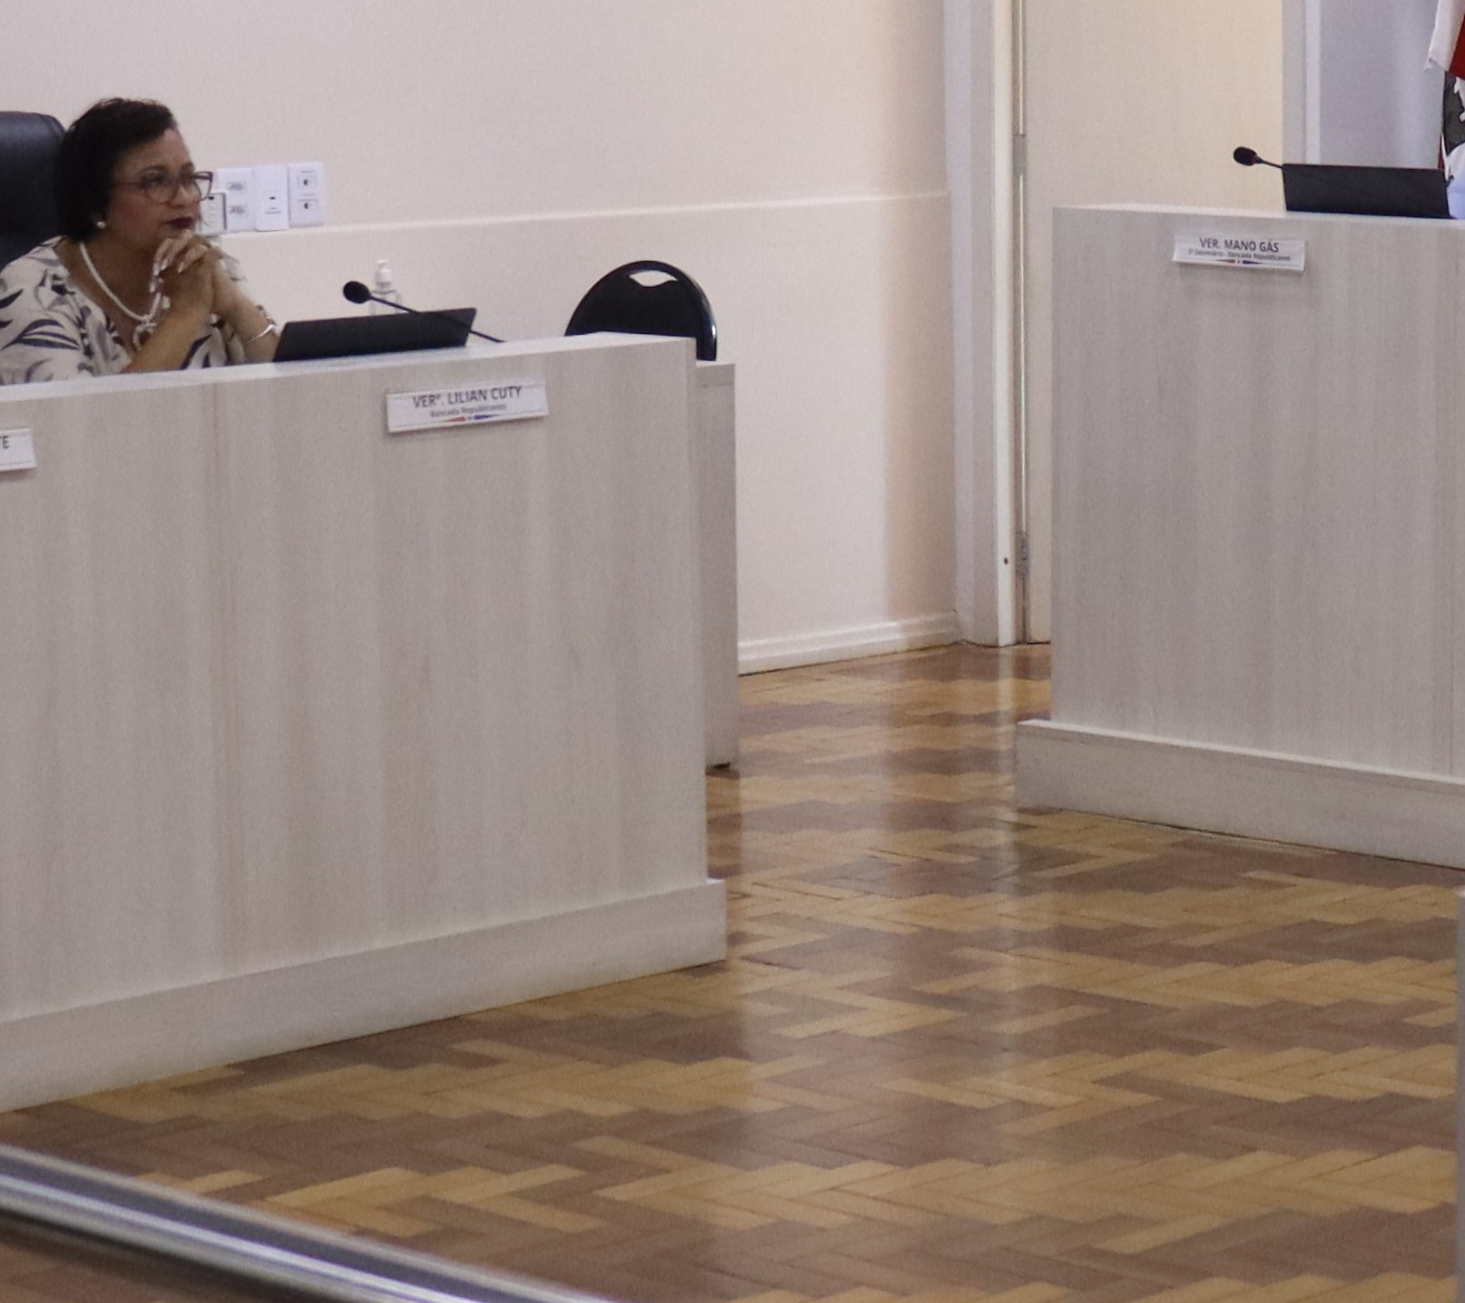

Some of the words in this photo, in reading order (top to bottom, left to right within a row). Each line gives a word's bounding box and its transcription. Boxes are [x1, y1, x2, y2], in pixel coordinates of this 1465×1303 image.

[1225, 239, 1257, 252] MANO
[447, 389, 488, 405] LILIAN
[490, 385, 523, 400] CUTY
